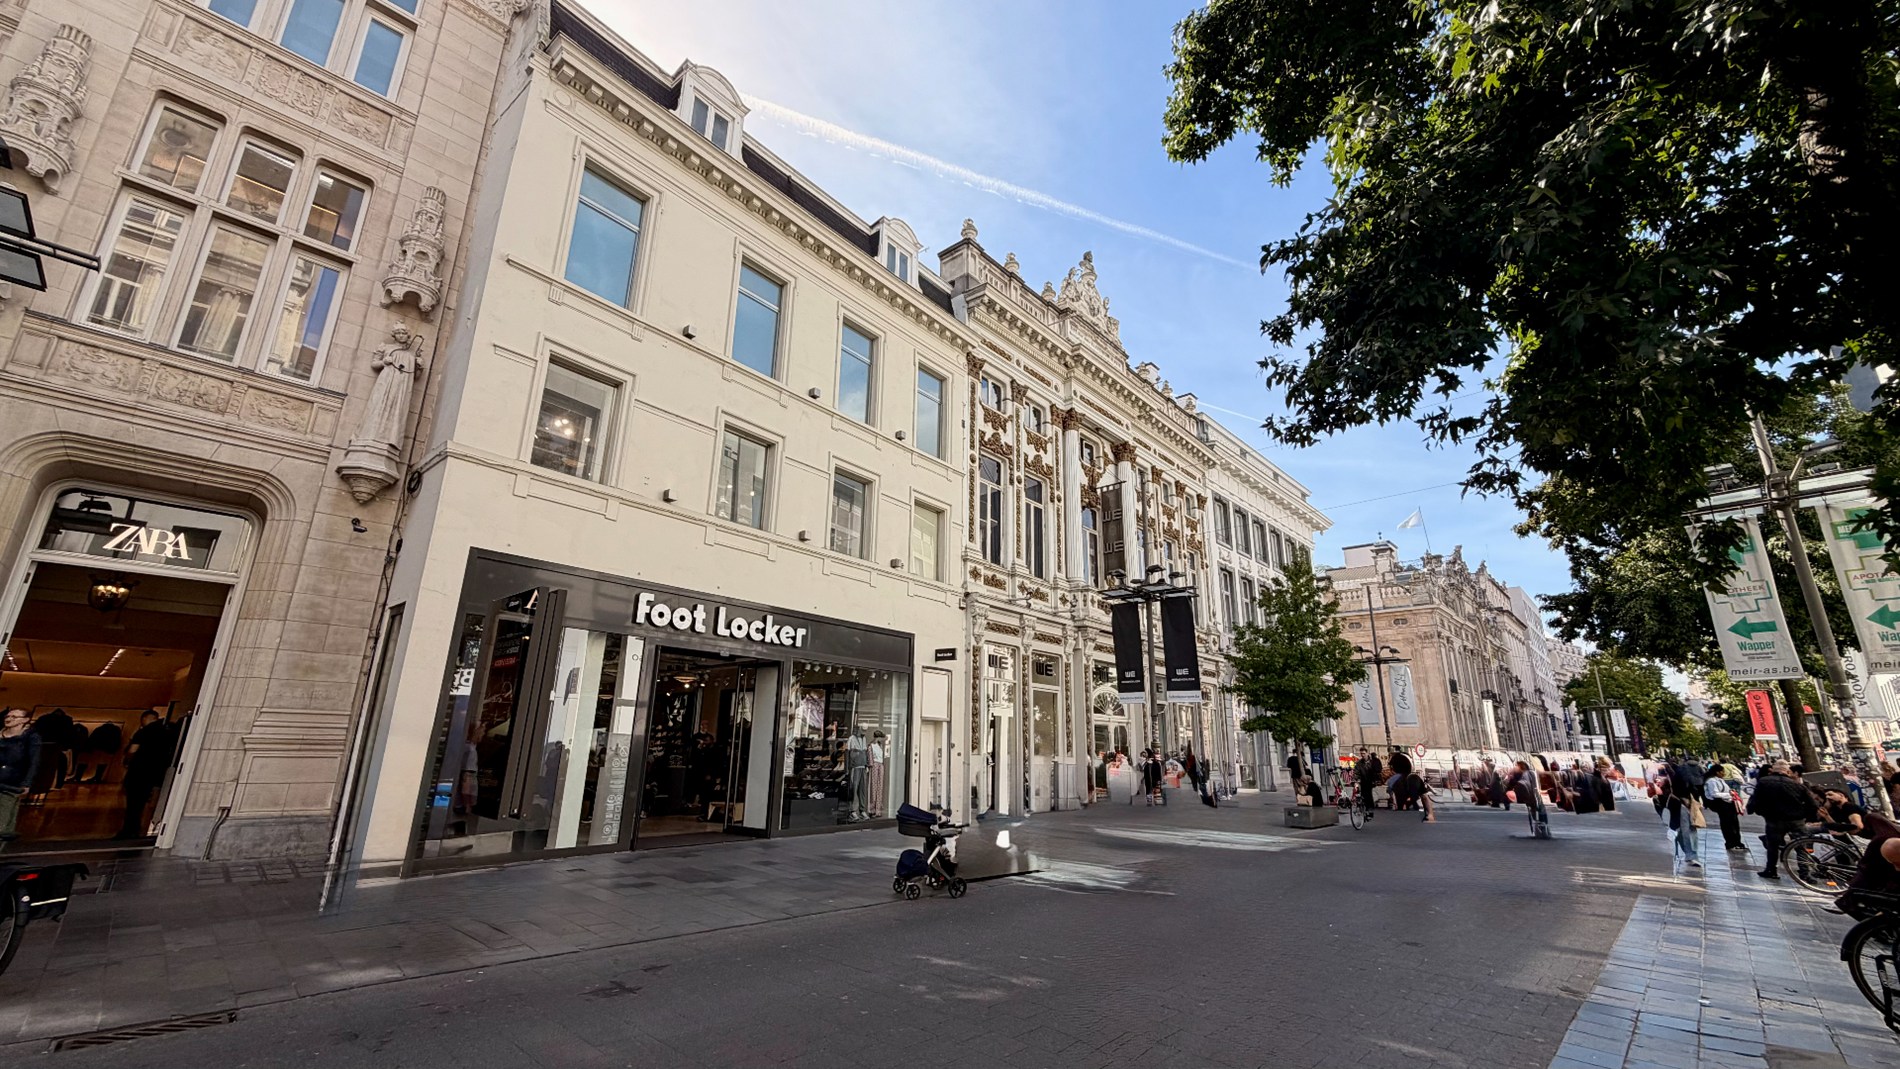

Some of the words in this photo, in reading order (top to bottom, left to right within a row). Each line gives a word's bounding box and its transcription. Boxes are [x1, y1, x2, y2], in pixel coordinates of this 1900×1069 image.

[102, 523, 193, 561] ZARA
[635, 592, 706, 633] Foot
[716, 606, 807, 648] Locker
[1737, 640, 1776, 652] Wapper
[987, 653, 1009, 670] WE
[1035, 661, 1054, 677] WE
[1125, 670, 1136, 678] WE
[1176, 668, 1190, 676] WE
[1730, 665, 1799, 676] meir-as.be
